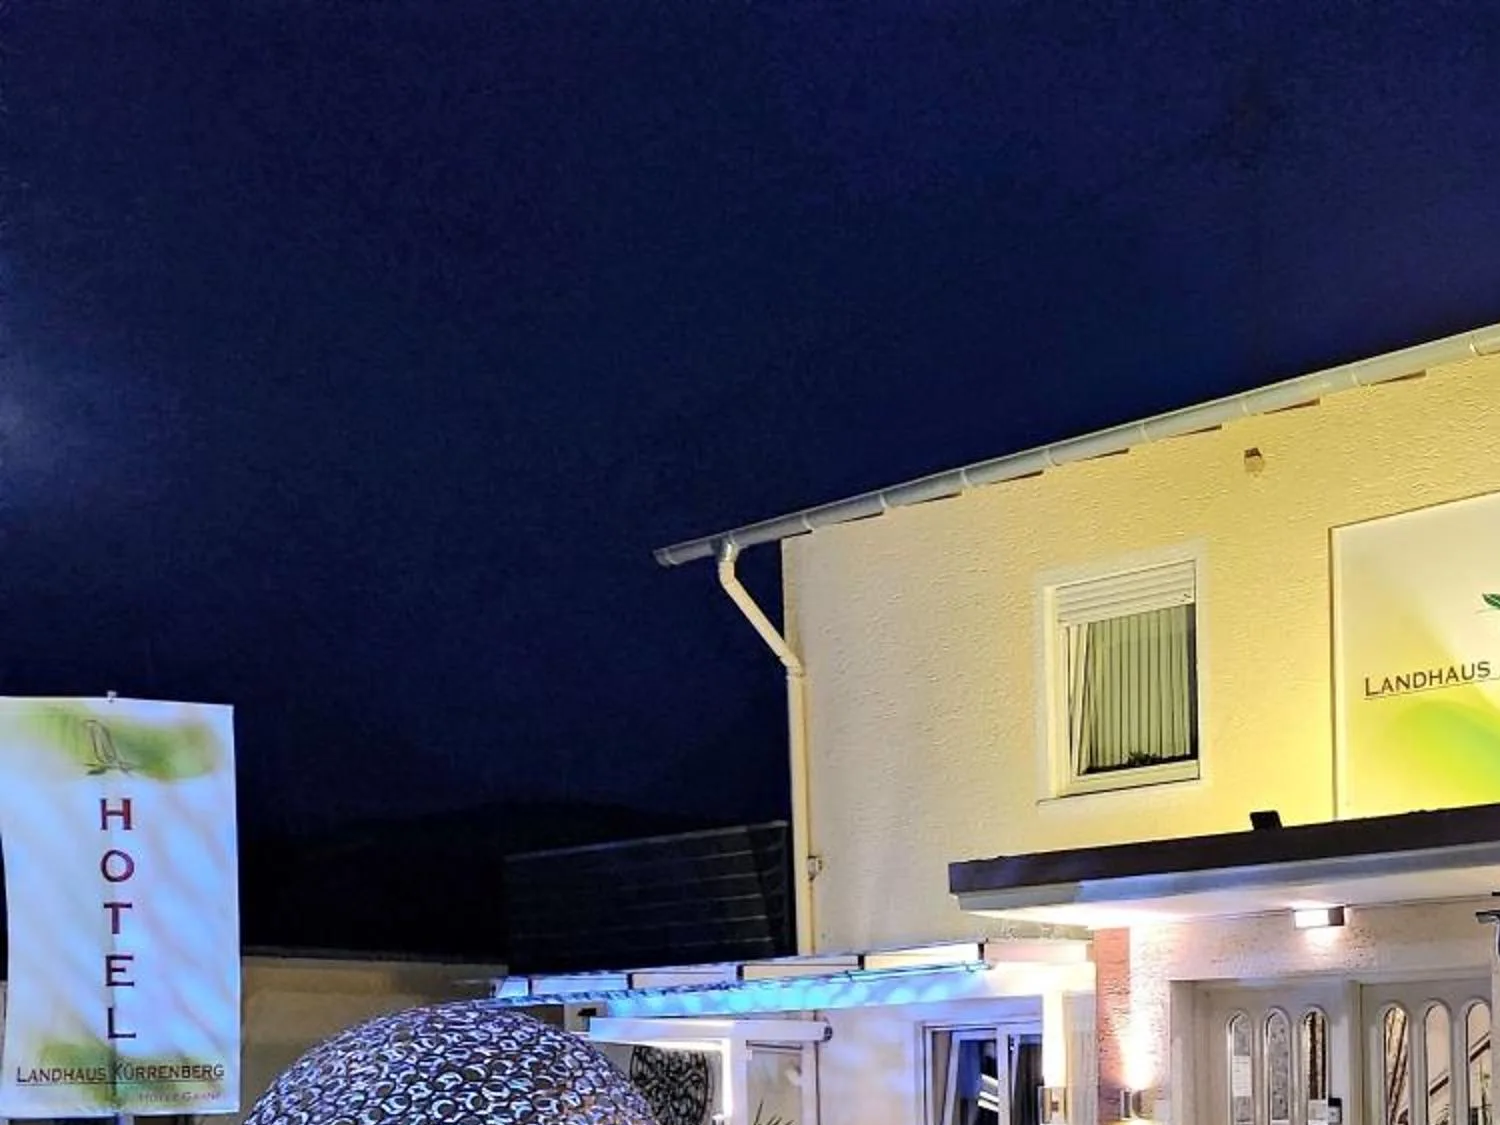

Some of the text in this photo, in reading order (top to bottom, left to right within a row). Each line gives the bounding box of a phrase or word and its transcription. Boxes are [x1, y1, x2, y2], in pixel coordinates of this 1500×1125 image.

[1364, 660, 1492, 697] LANDHAUS
[100, 797, 137, 1039] HOTEL
[16, 1065, 106, 1083] LANDHAUS
